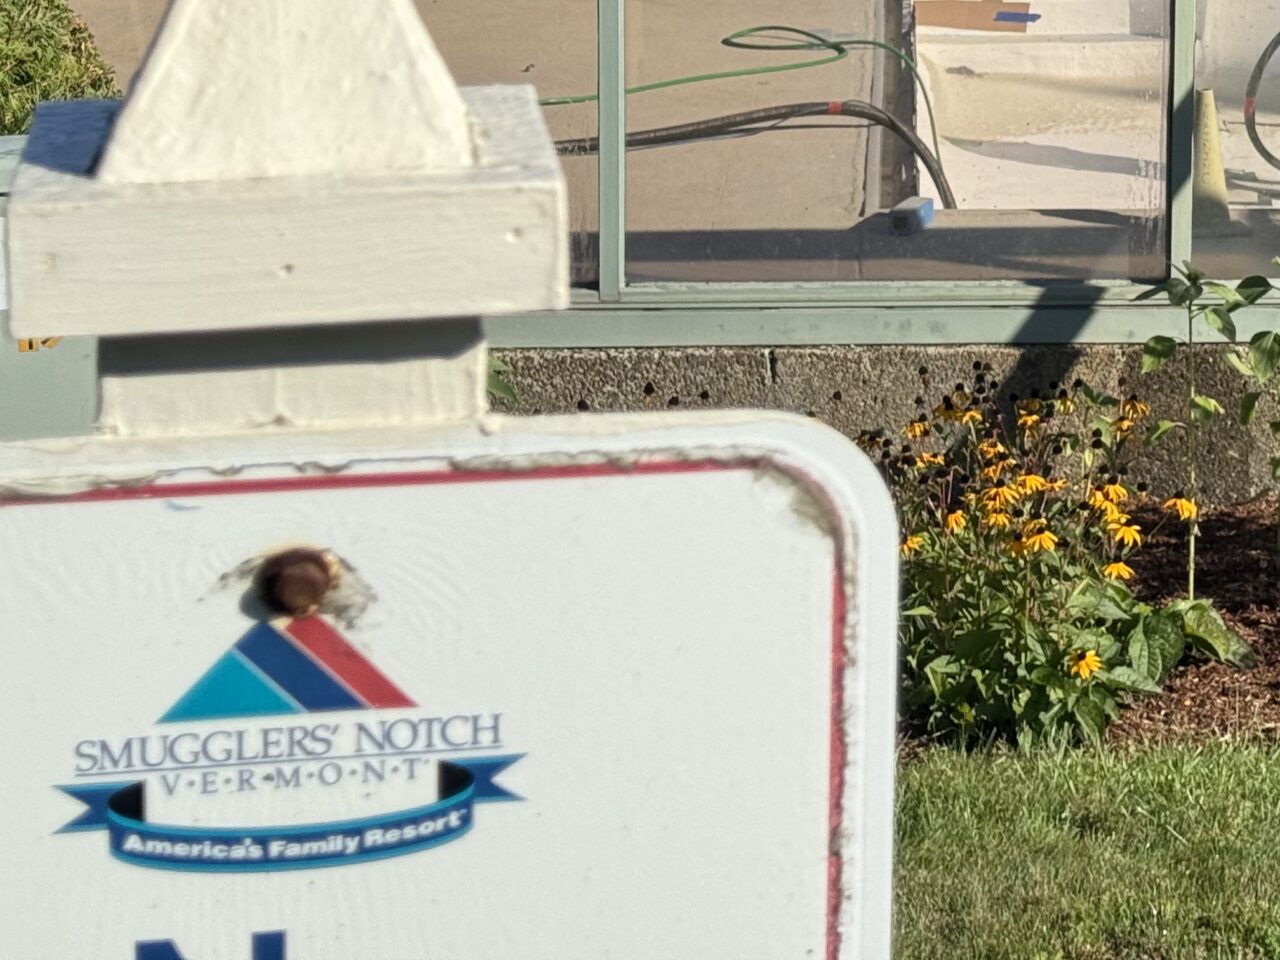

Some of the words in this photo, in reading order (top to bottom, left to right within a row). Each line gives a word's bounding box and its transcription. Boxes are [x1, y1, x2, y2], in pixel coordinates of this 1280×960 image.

[73, 723, 341, 774] SMUGGLERS'
[354, 713, 504, 754] NOTCH
[122, 833, 265, 860] America's
[268, 833, 361, 859] Family
[363, 811, 463, 848] Resort
